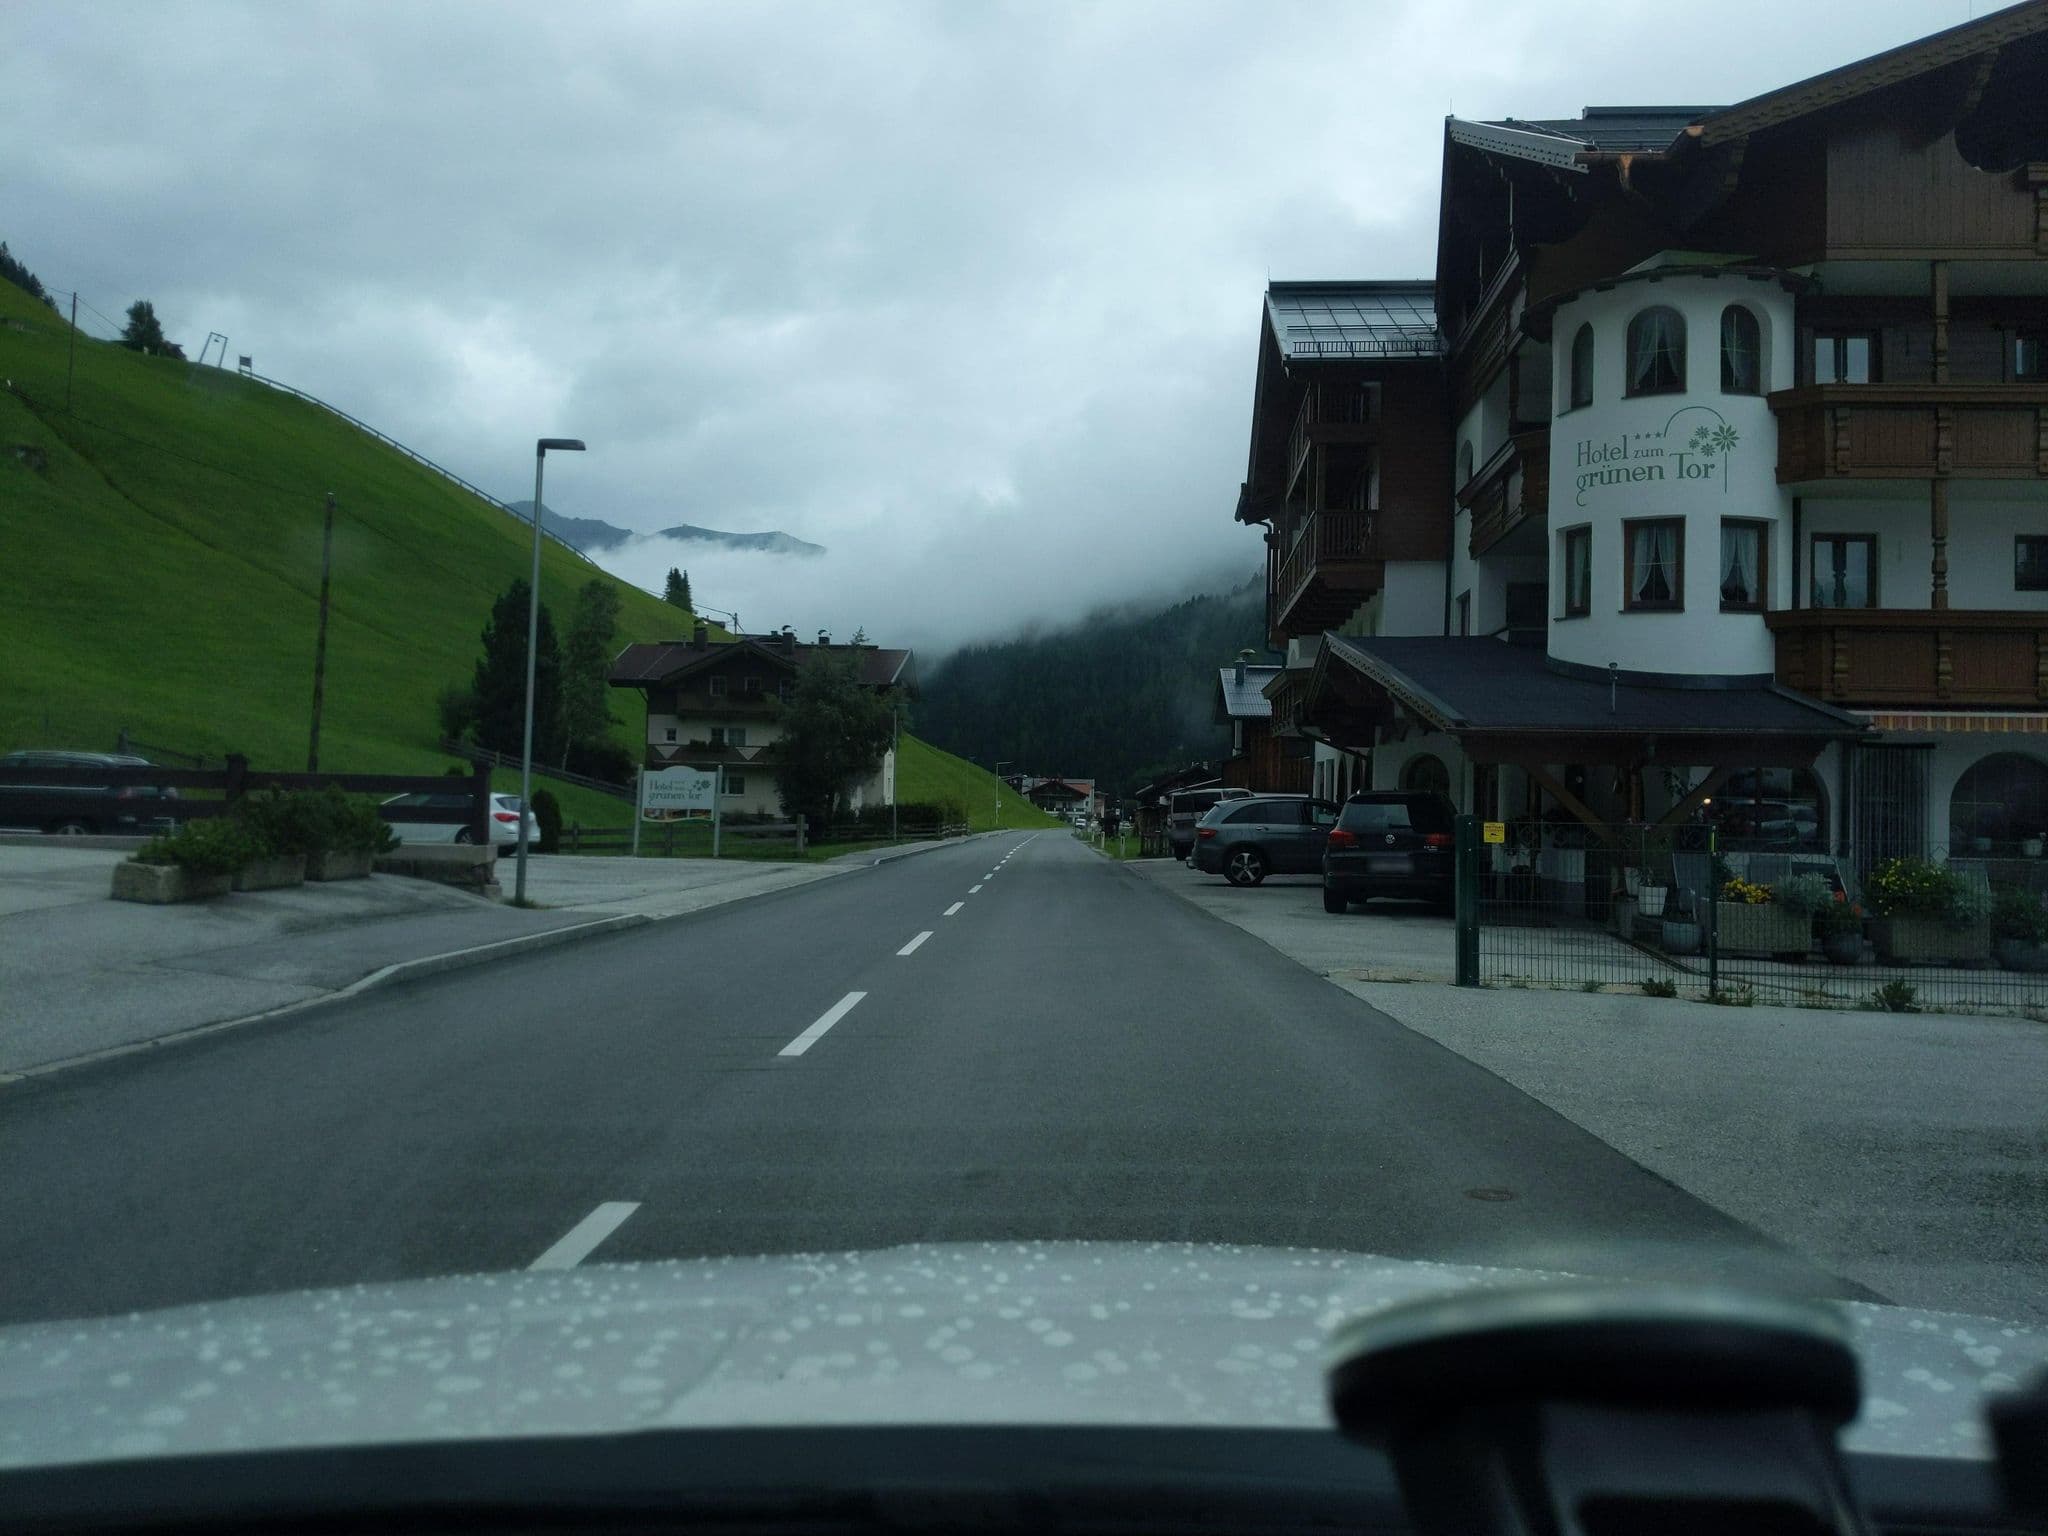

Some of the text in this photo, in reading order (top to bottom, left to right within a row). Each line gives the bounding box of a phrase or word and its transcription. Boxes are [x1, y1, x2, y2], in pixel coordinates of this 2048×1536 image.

[1577, 434, 1664, 467] Hotel zum
[1576, 452, 1715, 504] grünen Tor
